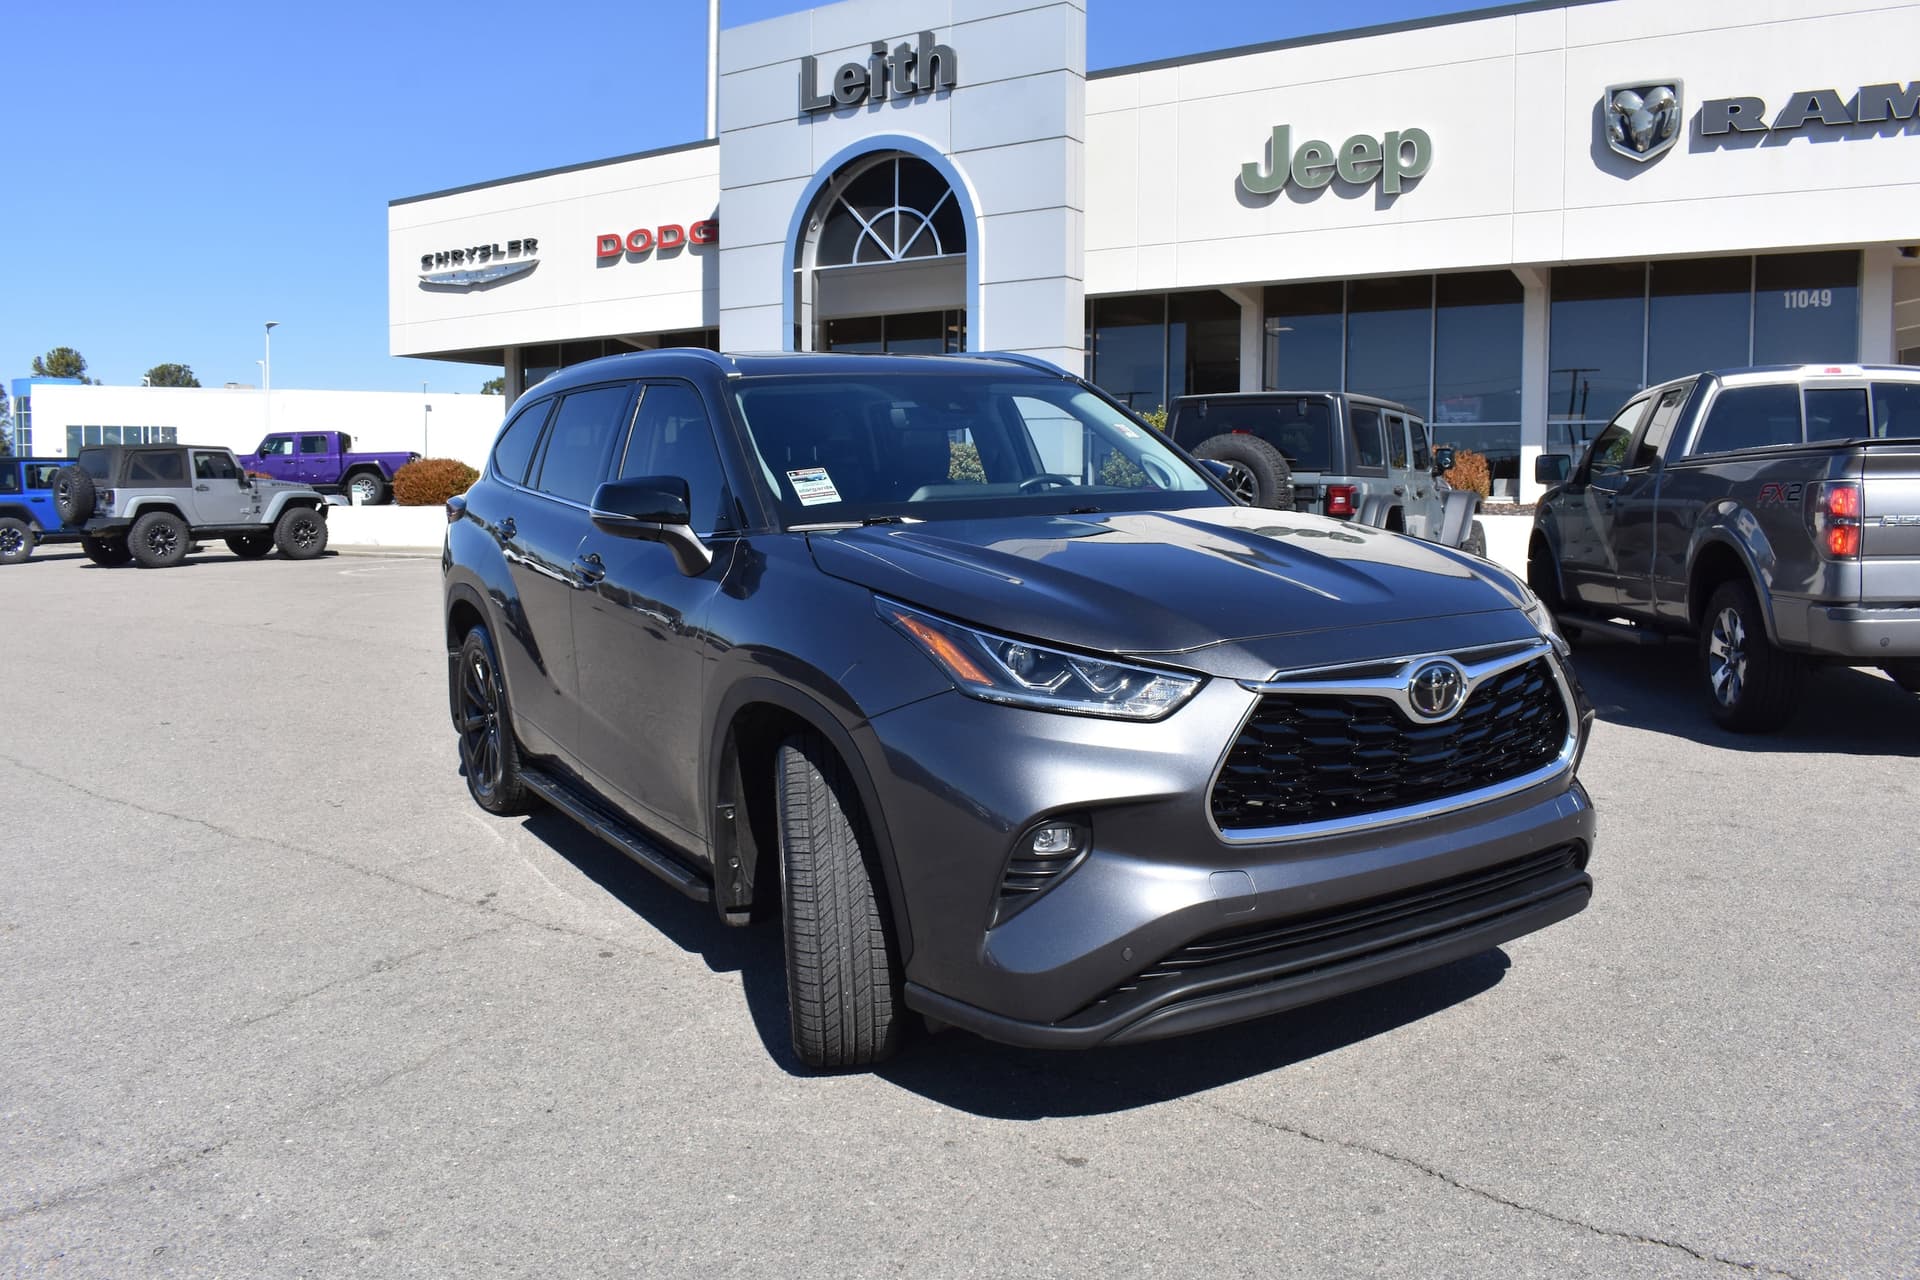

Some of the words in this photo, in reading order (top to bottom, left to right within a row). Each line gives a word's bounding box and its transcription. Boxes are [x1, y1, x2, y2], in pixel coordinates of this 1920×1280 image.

[800, 30, 957, 111] Leith
[1701, 80, 1920, 135] RAM
[1241, 124, 1432, 194] Jeep
[421, 238, 538, 268] CHRYSLER
[597, 219, 719, 257] DODG
[1783, 289, 1832, 309] 11049
[1759, 482, 1802, 502] FX2
